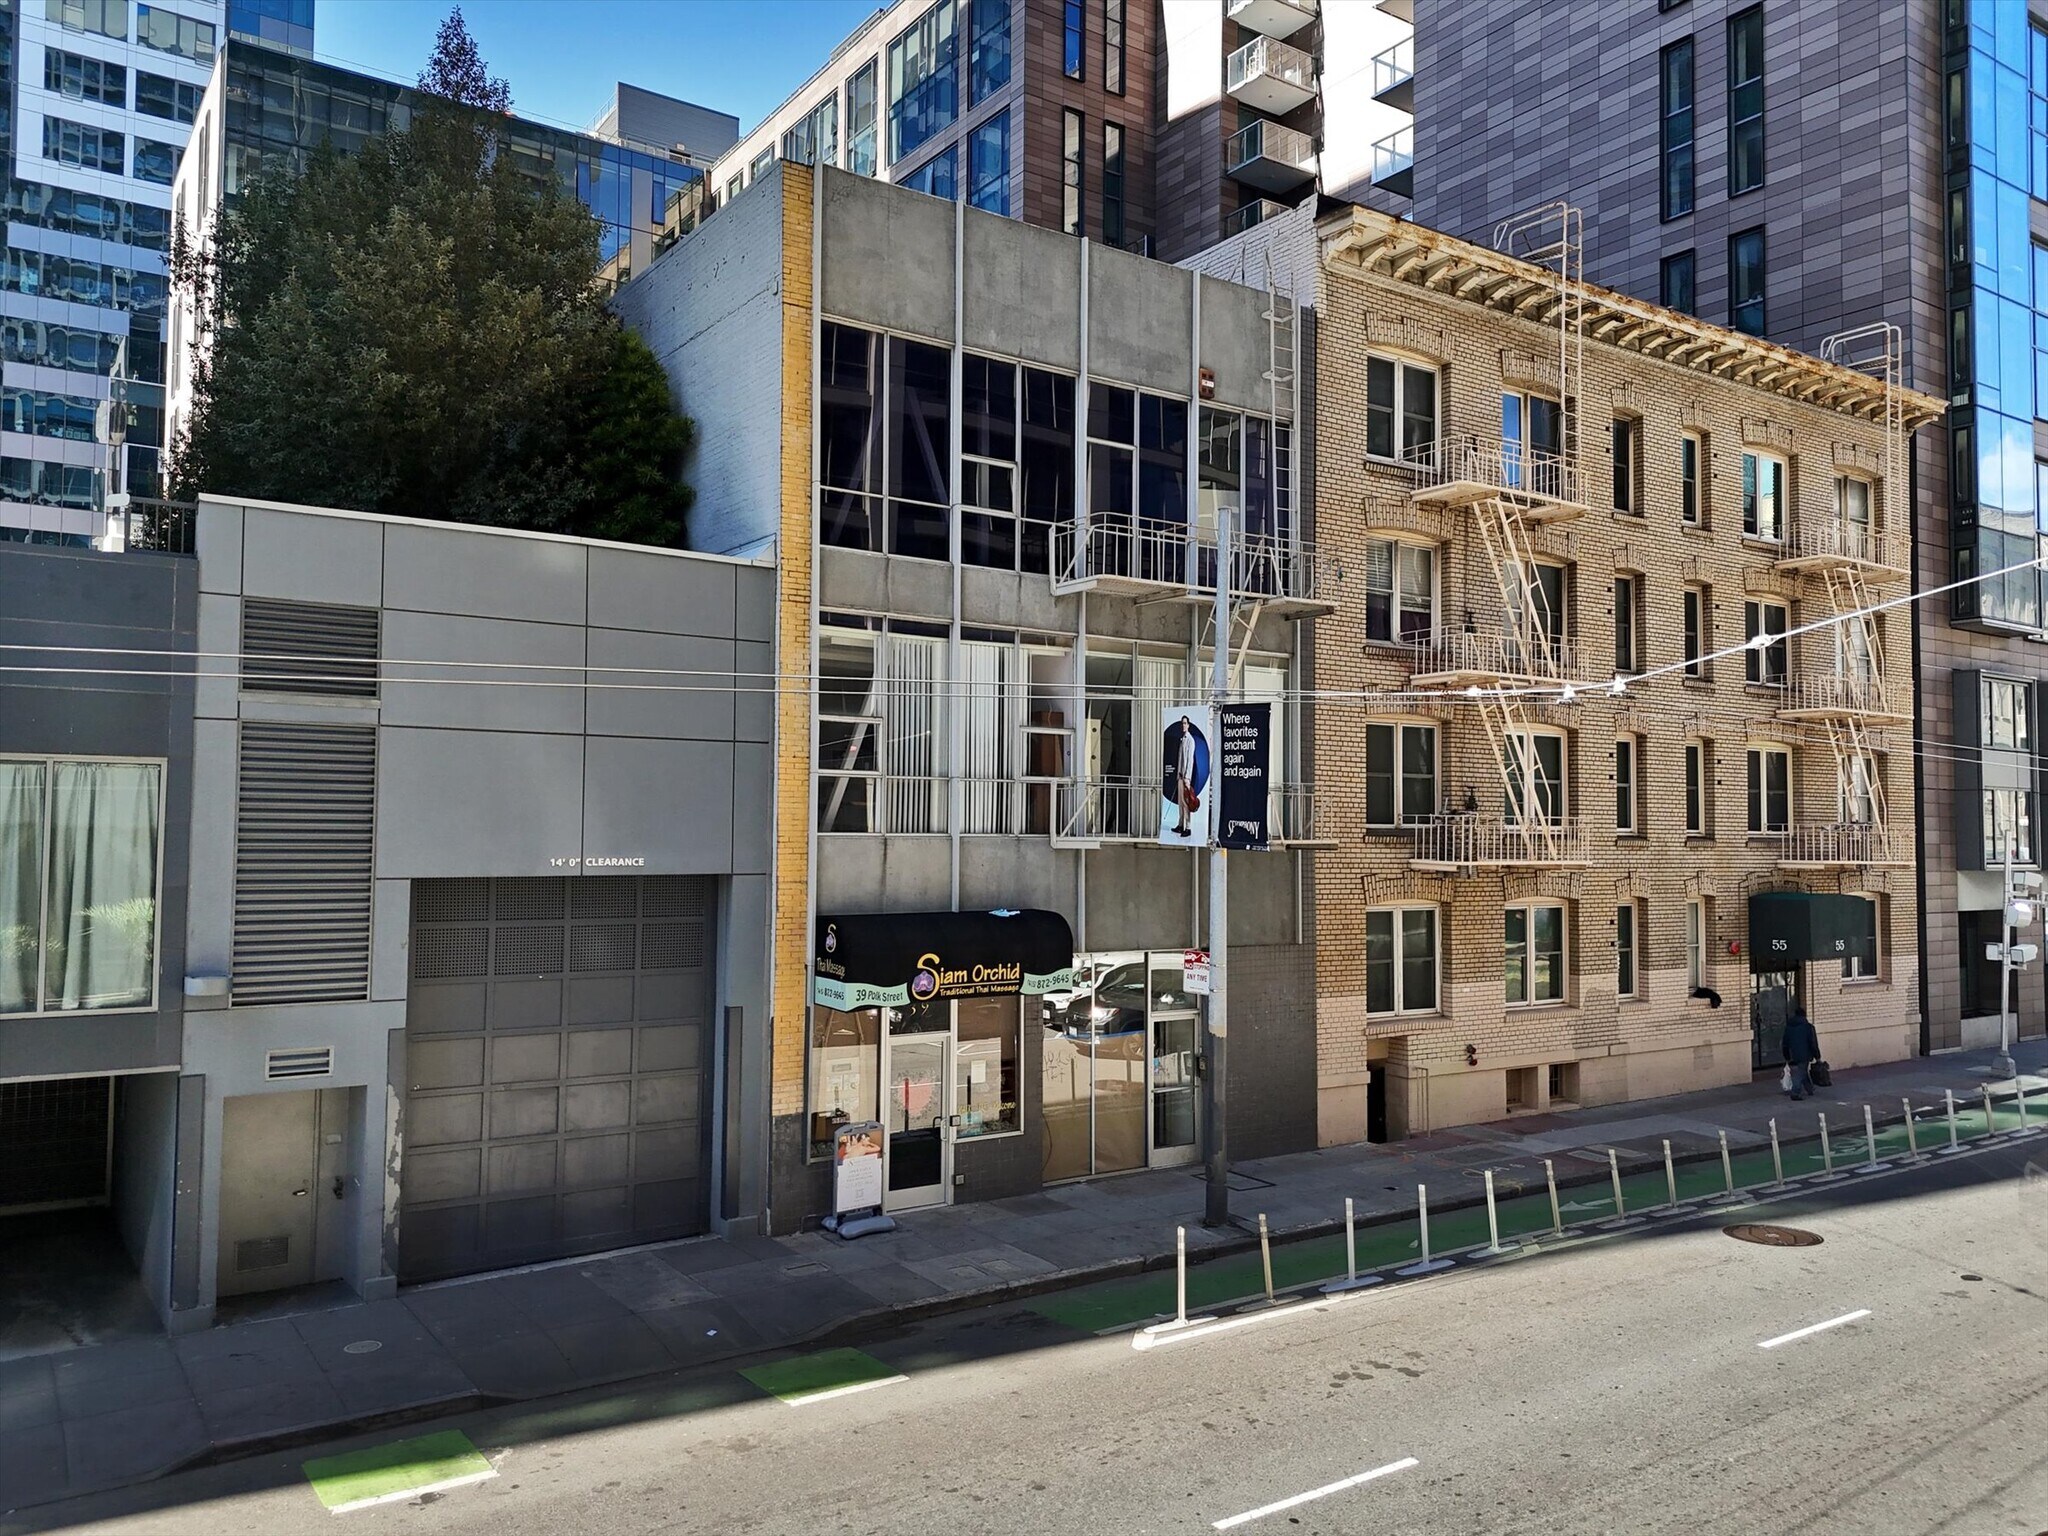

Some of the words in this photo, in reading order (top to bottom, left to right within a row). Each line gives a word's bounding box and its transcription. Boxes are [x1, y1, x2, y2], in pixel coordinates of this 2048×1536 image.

[1222, 713, 1250, 724] Where
[1223, 726, 1259, 737] favorites
[1223, 739, 1256, 750] enchant
[1223, 752, 1245, 766] again
[1223, 765, 1238, 777] and
[1238, 765, 1262, 779] again
[550, 858, 566, 867] 14'
[585, 858, 645, 867] CLEARANCE
[1771, 939, 1788, 951] 55
[1835, 939, 1845, 951] 55
[912, 953, 968, 1000] Siam
[972, 962, 1020, 982] Orchid
[1036, 972, 1070, 989] 872-9645
[1186, 973, 1196, 981] ANY
[1196, 974, 1208, 982] TIME
[855, 989, 867, 1001] 39
[867, 990, 881, 1001] Polk
[881, 991, 903, 1002] Street
[940, 986, 975, 997] Traditional
[976, 985, 989, 994] Thai
[990, 983, 1019, 993] Massage
